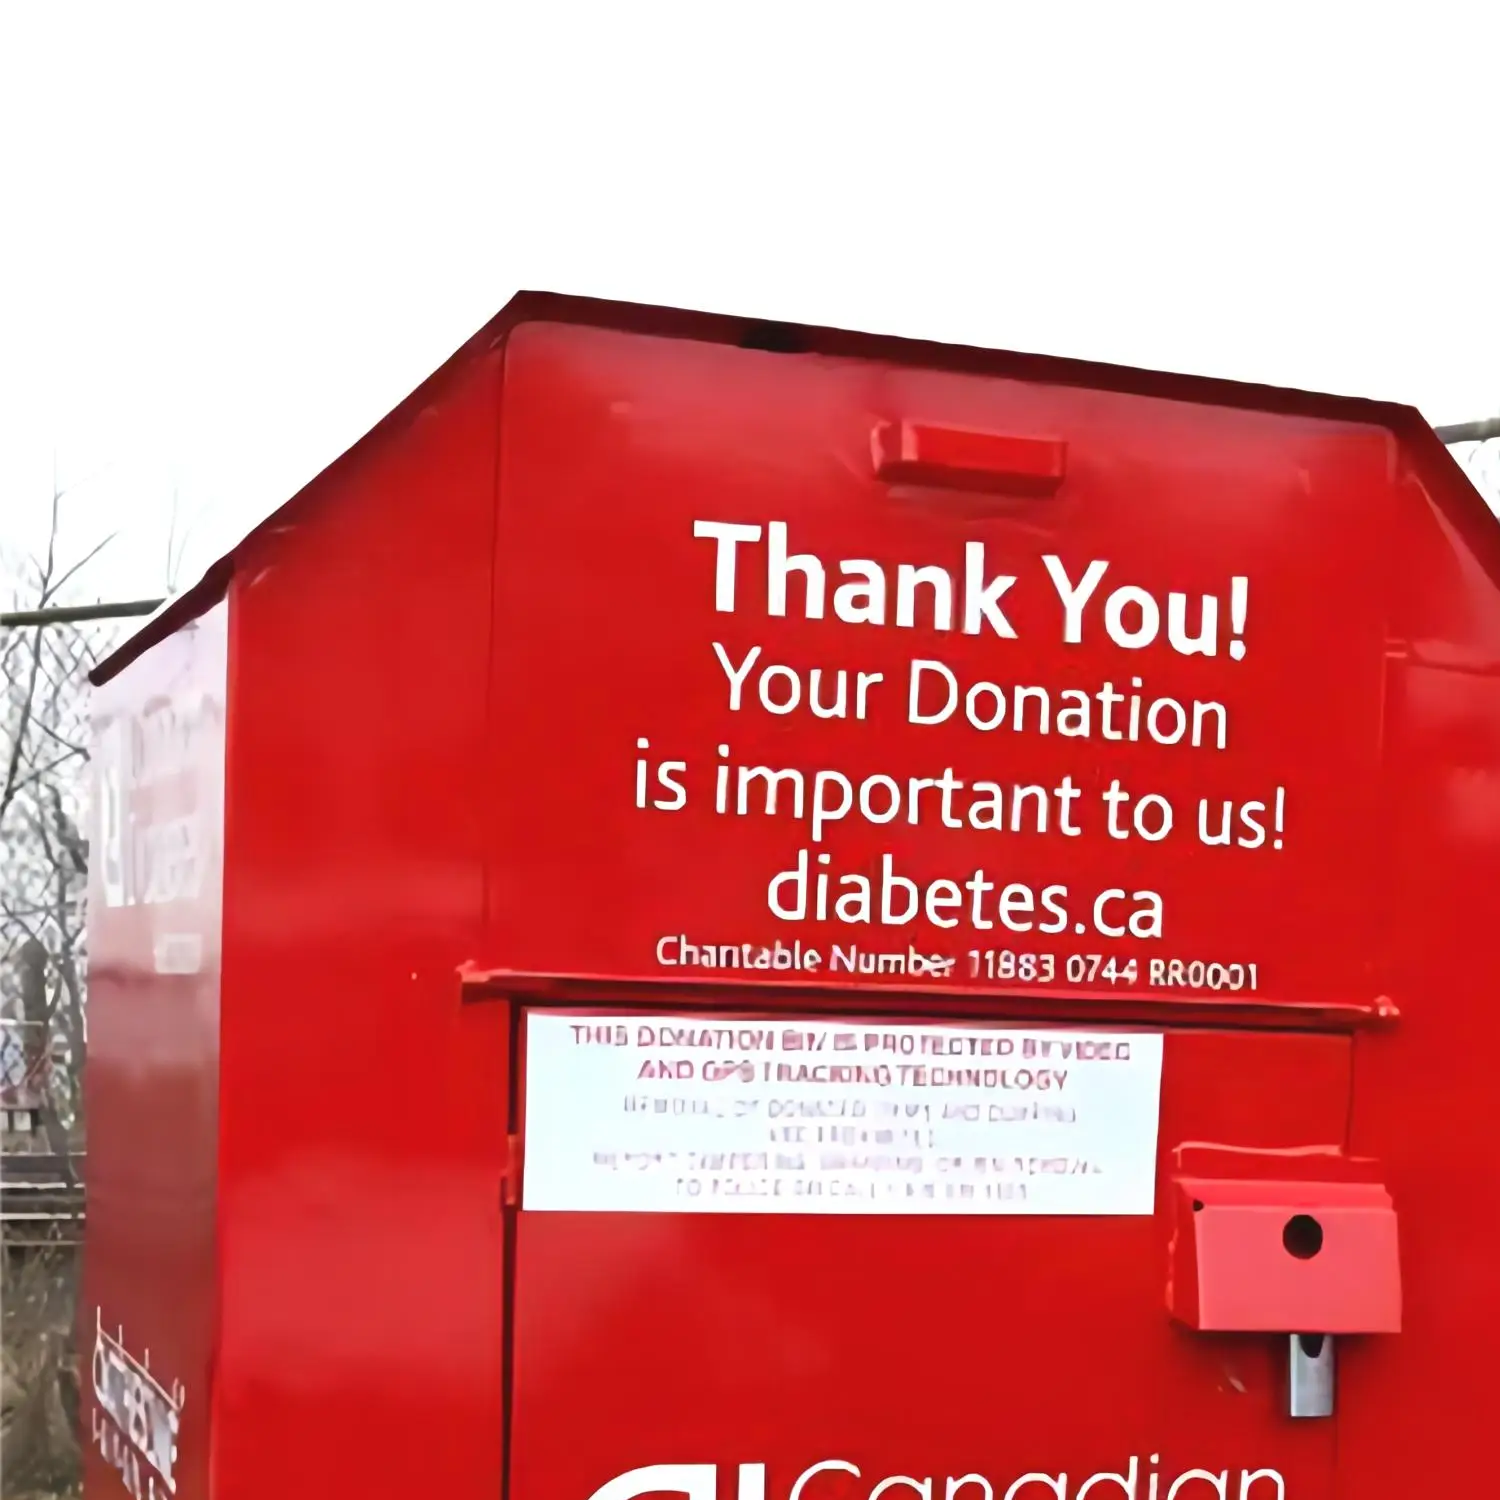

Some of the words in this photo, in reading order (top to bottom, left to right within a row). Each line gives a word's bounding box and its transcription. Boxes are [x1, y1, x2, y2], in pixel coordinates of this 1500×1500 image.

[694, 520, 1018, 640] Thank
[1042, 554, 1249, 661] You!
[712, 642, 883, 719] Your
[908, 659, 1226, 748] Donation
[635, 738, 687, 811] is
[715, 745, 1082, 841] important
[1104, 780, 1173, 841] to
[1199, 787, 1285, 849] us!
[768, 851, 1163, 938] diabetes.ca
[829, 945, 955, 977] Number
[968, 950, 1054, 982] 11883
[1066, 954, 1137, 986] 0744
